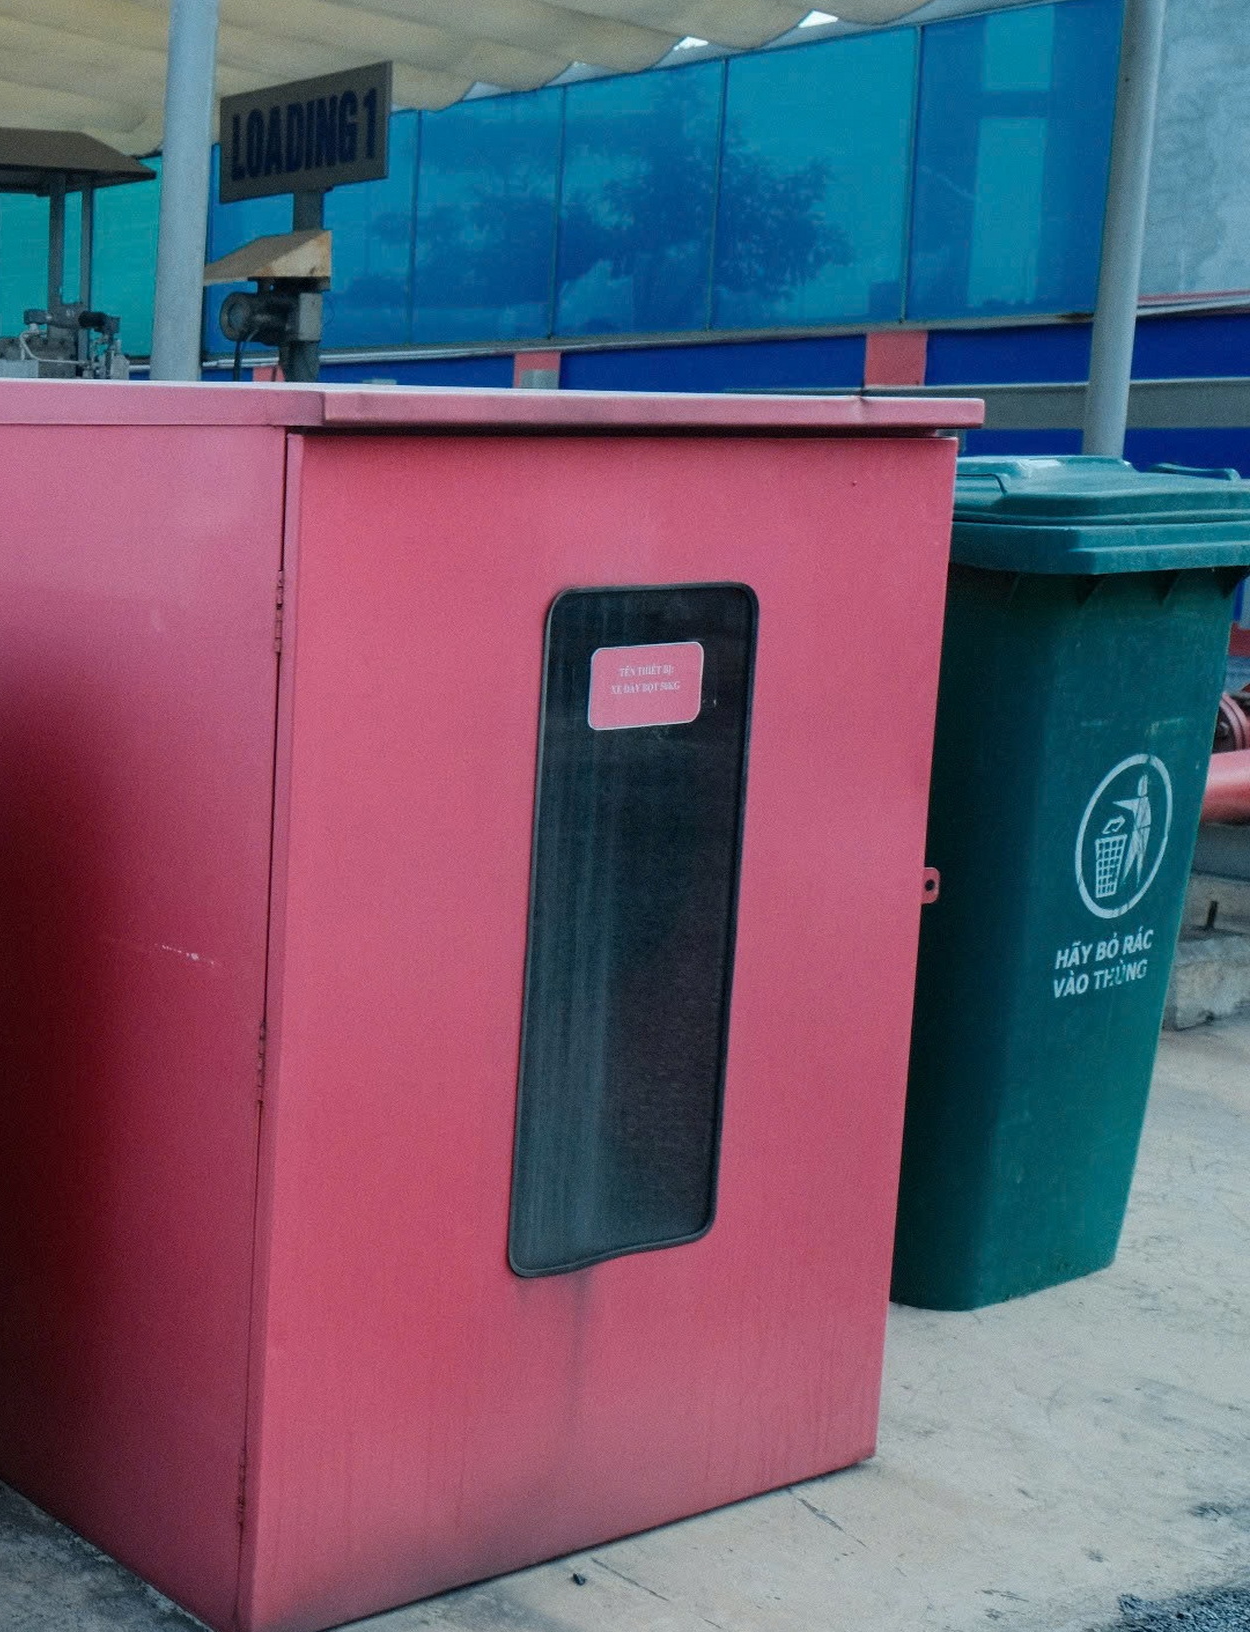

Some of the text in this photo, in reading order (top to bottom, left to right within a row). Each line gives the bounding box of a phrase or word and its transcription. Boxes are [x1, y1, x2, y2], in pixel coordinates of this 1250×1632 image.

[231, 86, 377, 182] LOADING 1
[1054, 925, 1154, 970] HÃY BỎ RÁC
[1053, 958, 1148, 999] VÀO THÙNG
